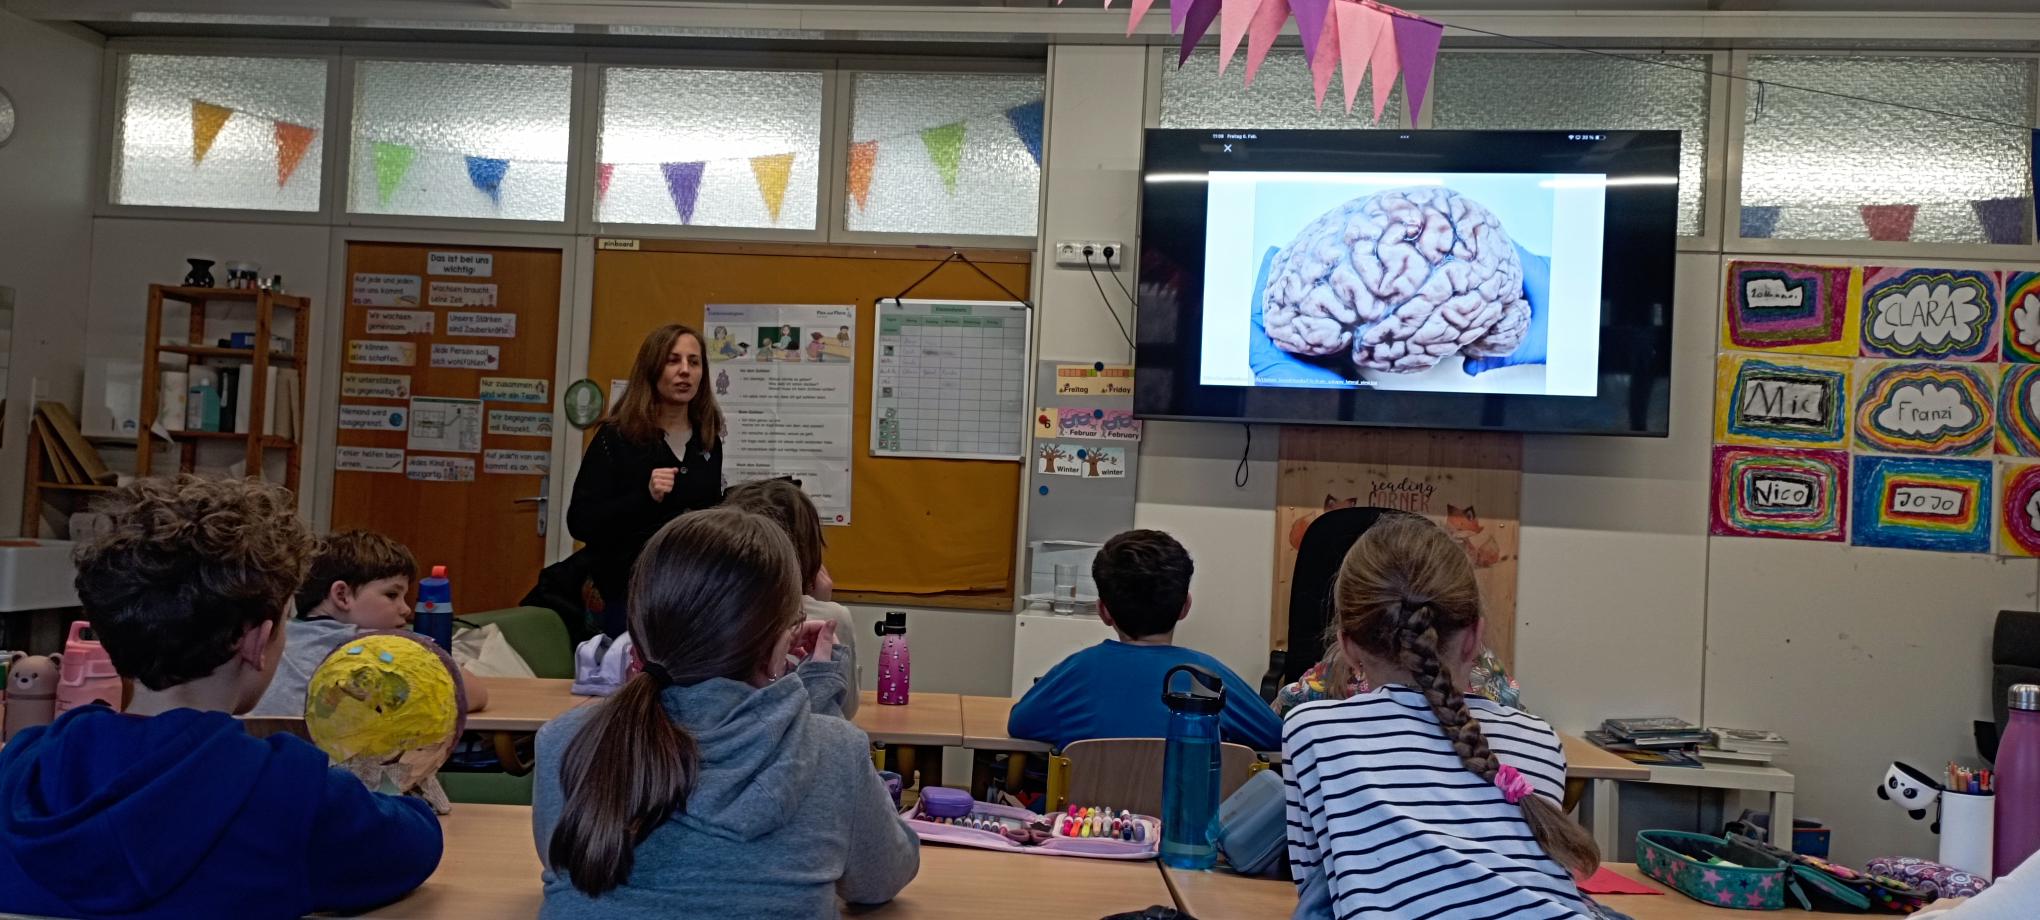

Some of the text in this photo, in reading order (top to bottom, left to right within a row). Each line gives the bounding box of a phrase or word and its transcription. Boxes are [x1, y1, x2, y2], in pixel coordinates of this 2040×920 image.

[604, 240, 634, 249] pinboard
[431, 253, 445, 262] Das
[448, 254, 458, 263] ist
[461, 254, 473, 263] bei
[431, 284, 462, 293] Wachsen
[450, 314, 473, 322] Unsere
[1885, 301, 1957, 327] CLARA
[450, 347, 473, 355] Person
[1064, 386, 1088, 394] Freitag
[1108, 386, 1131, 394] Friday
[1744, 382, 1811, 416] Mic
[1899, 401, 1952, 424] Franzi
[1070, 429, 1097, 437] Februar
[1108, 431, 1139, 440] February
[1371, 478, 1437, 497] reading
[1756, 482, 1805, 504] Nico
[1368, 491, 1431, 513] CORNER
